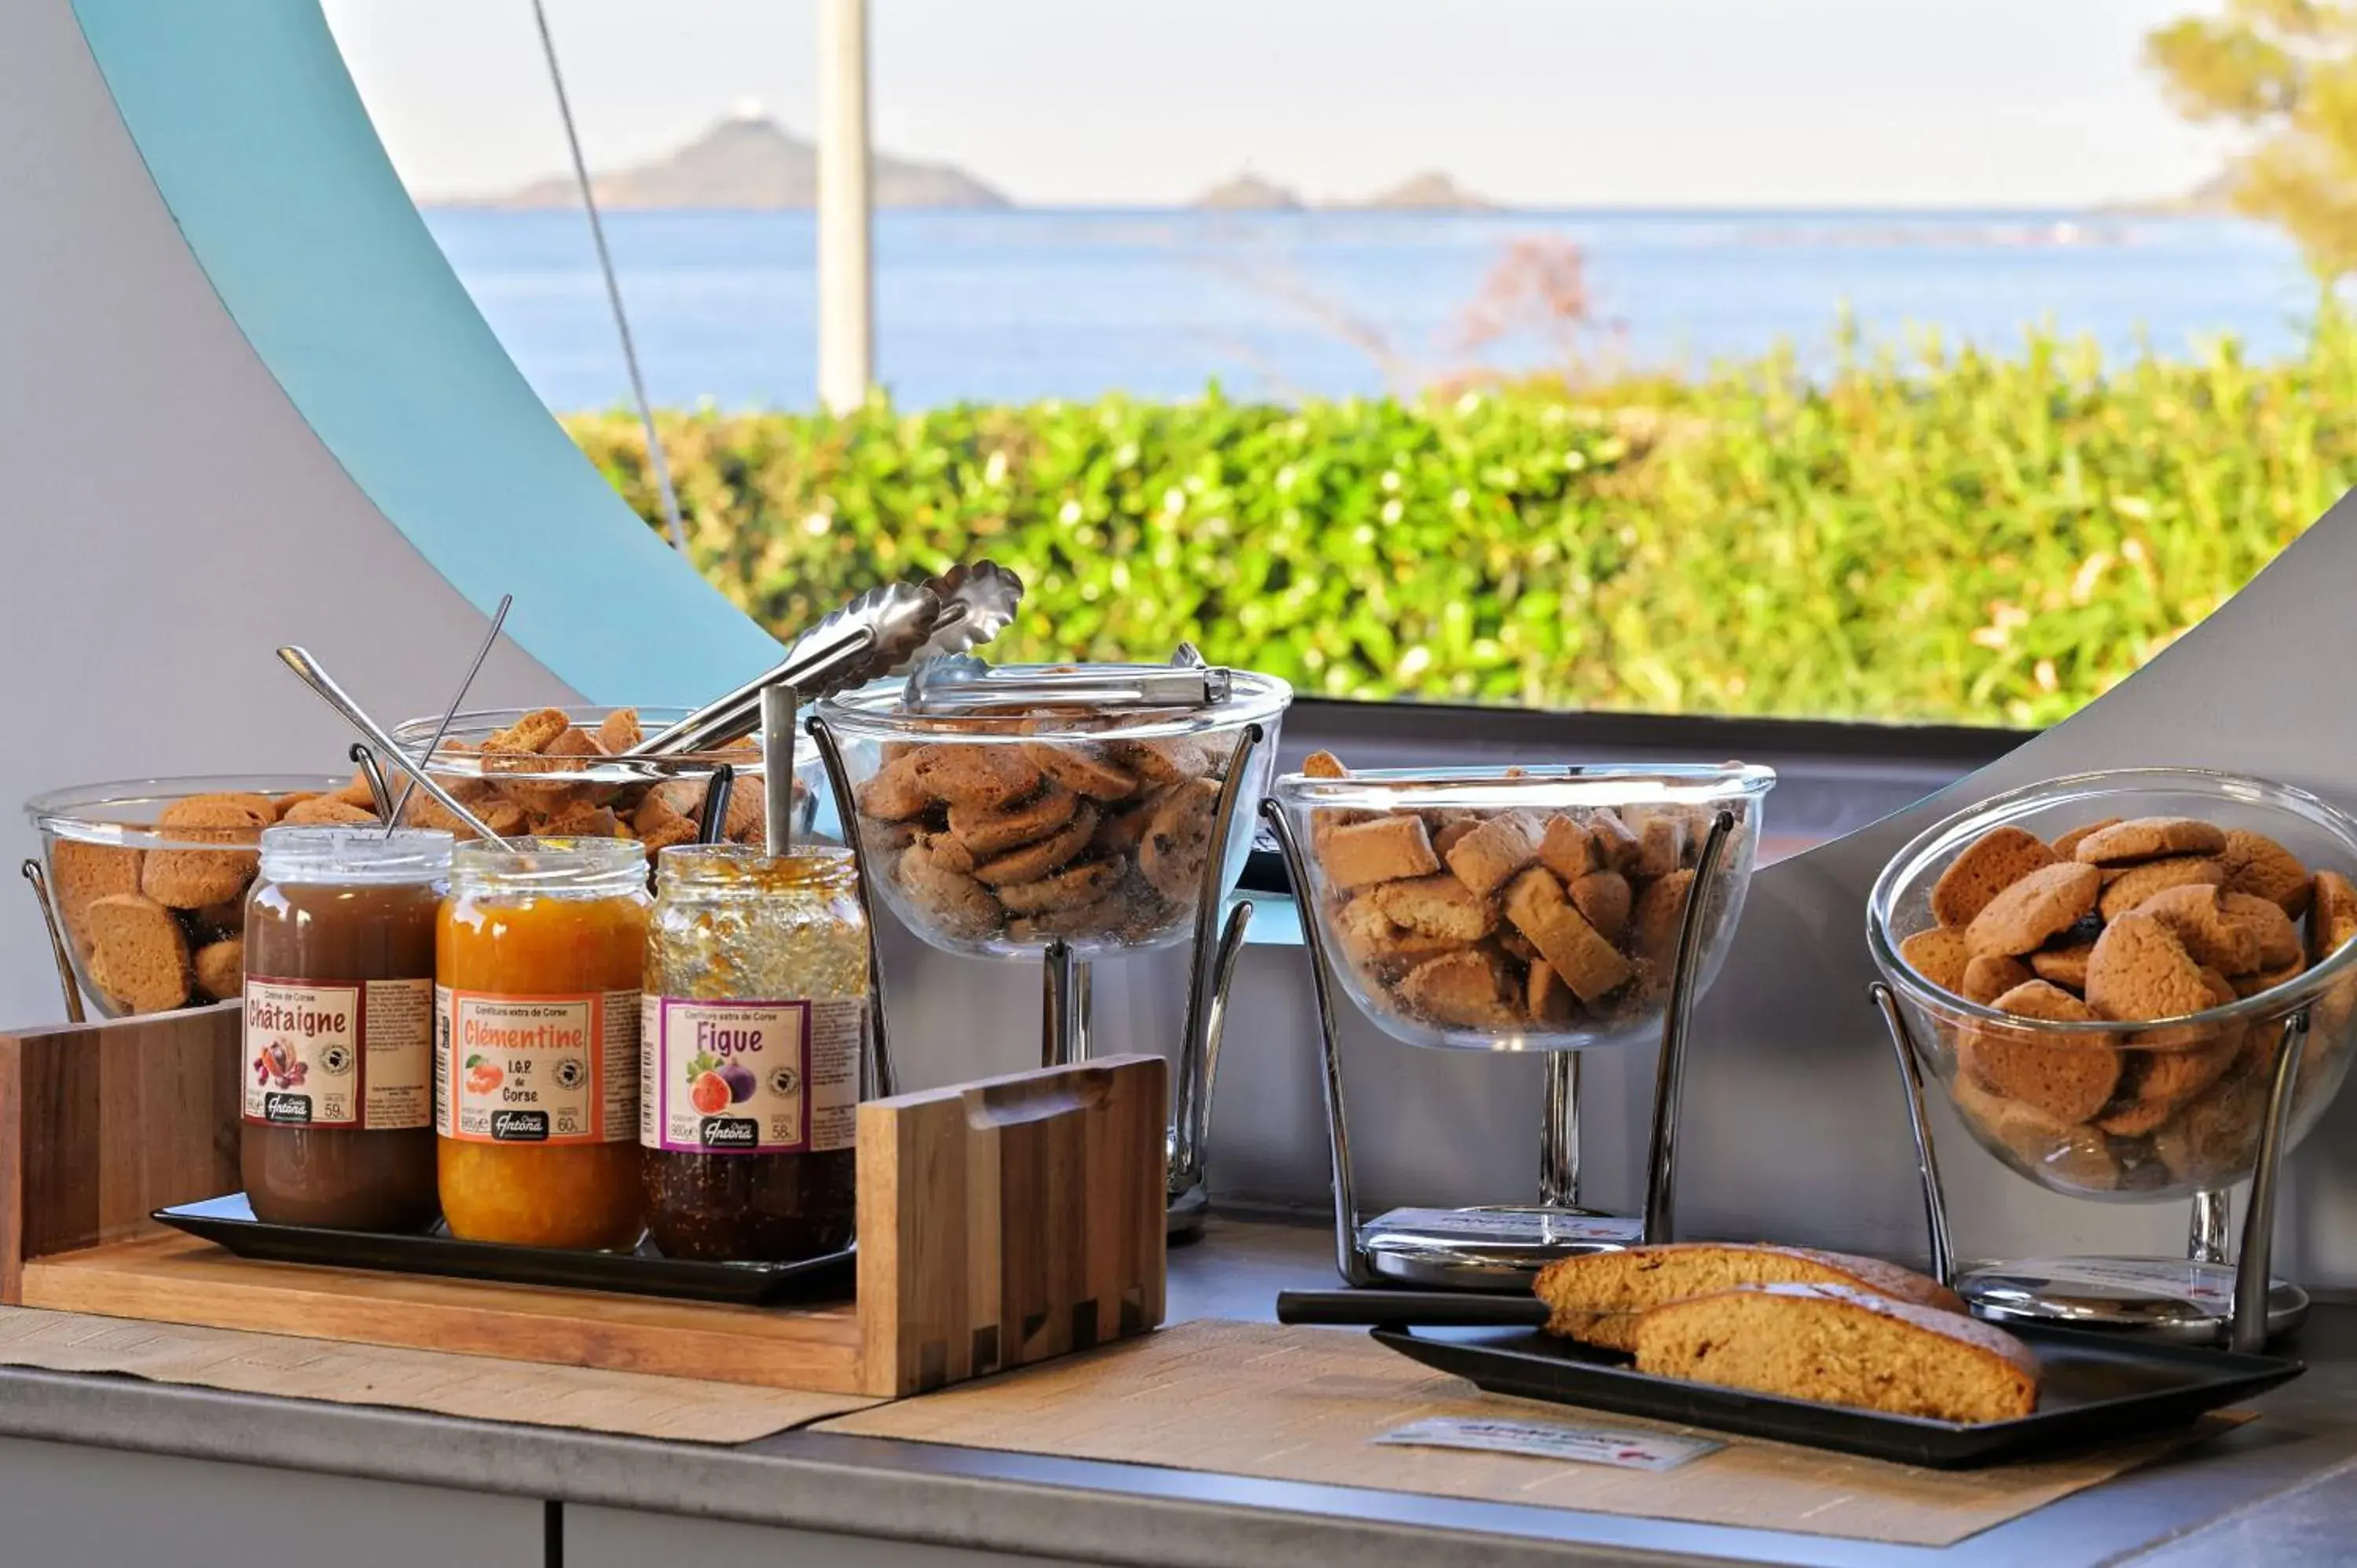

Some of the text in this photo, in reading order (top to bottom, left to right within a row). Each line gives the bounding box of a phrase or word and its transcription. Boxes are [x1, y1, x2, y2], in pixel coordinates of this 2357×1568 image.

[249, 998, 346, 1038] Châtaigne
[509, 1008, 529, 1017] extra
[530, 1007, 541, 1017] de
[543, 1008, 568, 1017] Corse
[719, 1012, 739, 1021] extra
[741, 1012, 751, 1020] de
[753, 1012, 778, 1021] Corse
[464, 1018, 583, 1050] Clémentine
[696, 1020, 764, 1057] Figue
[268, 1094, 308, 1119] Antona
[502, 1087, 538, 1103] Corse
[496, 1112, 544, 1138] Antona
[704, 1119, 753, 1145] Antona
